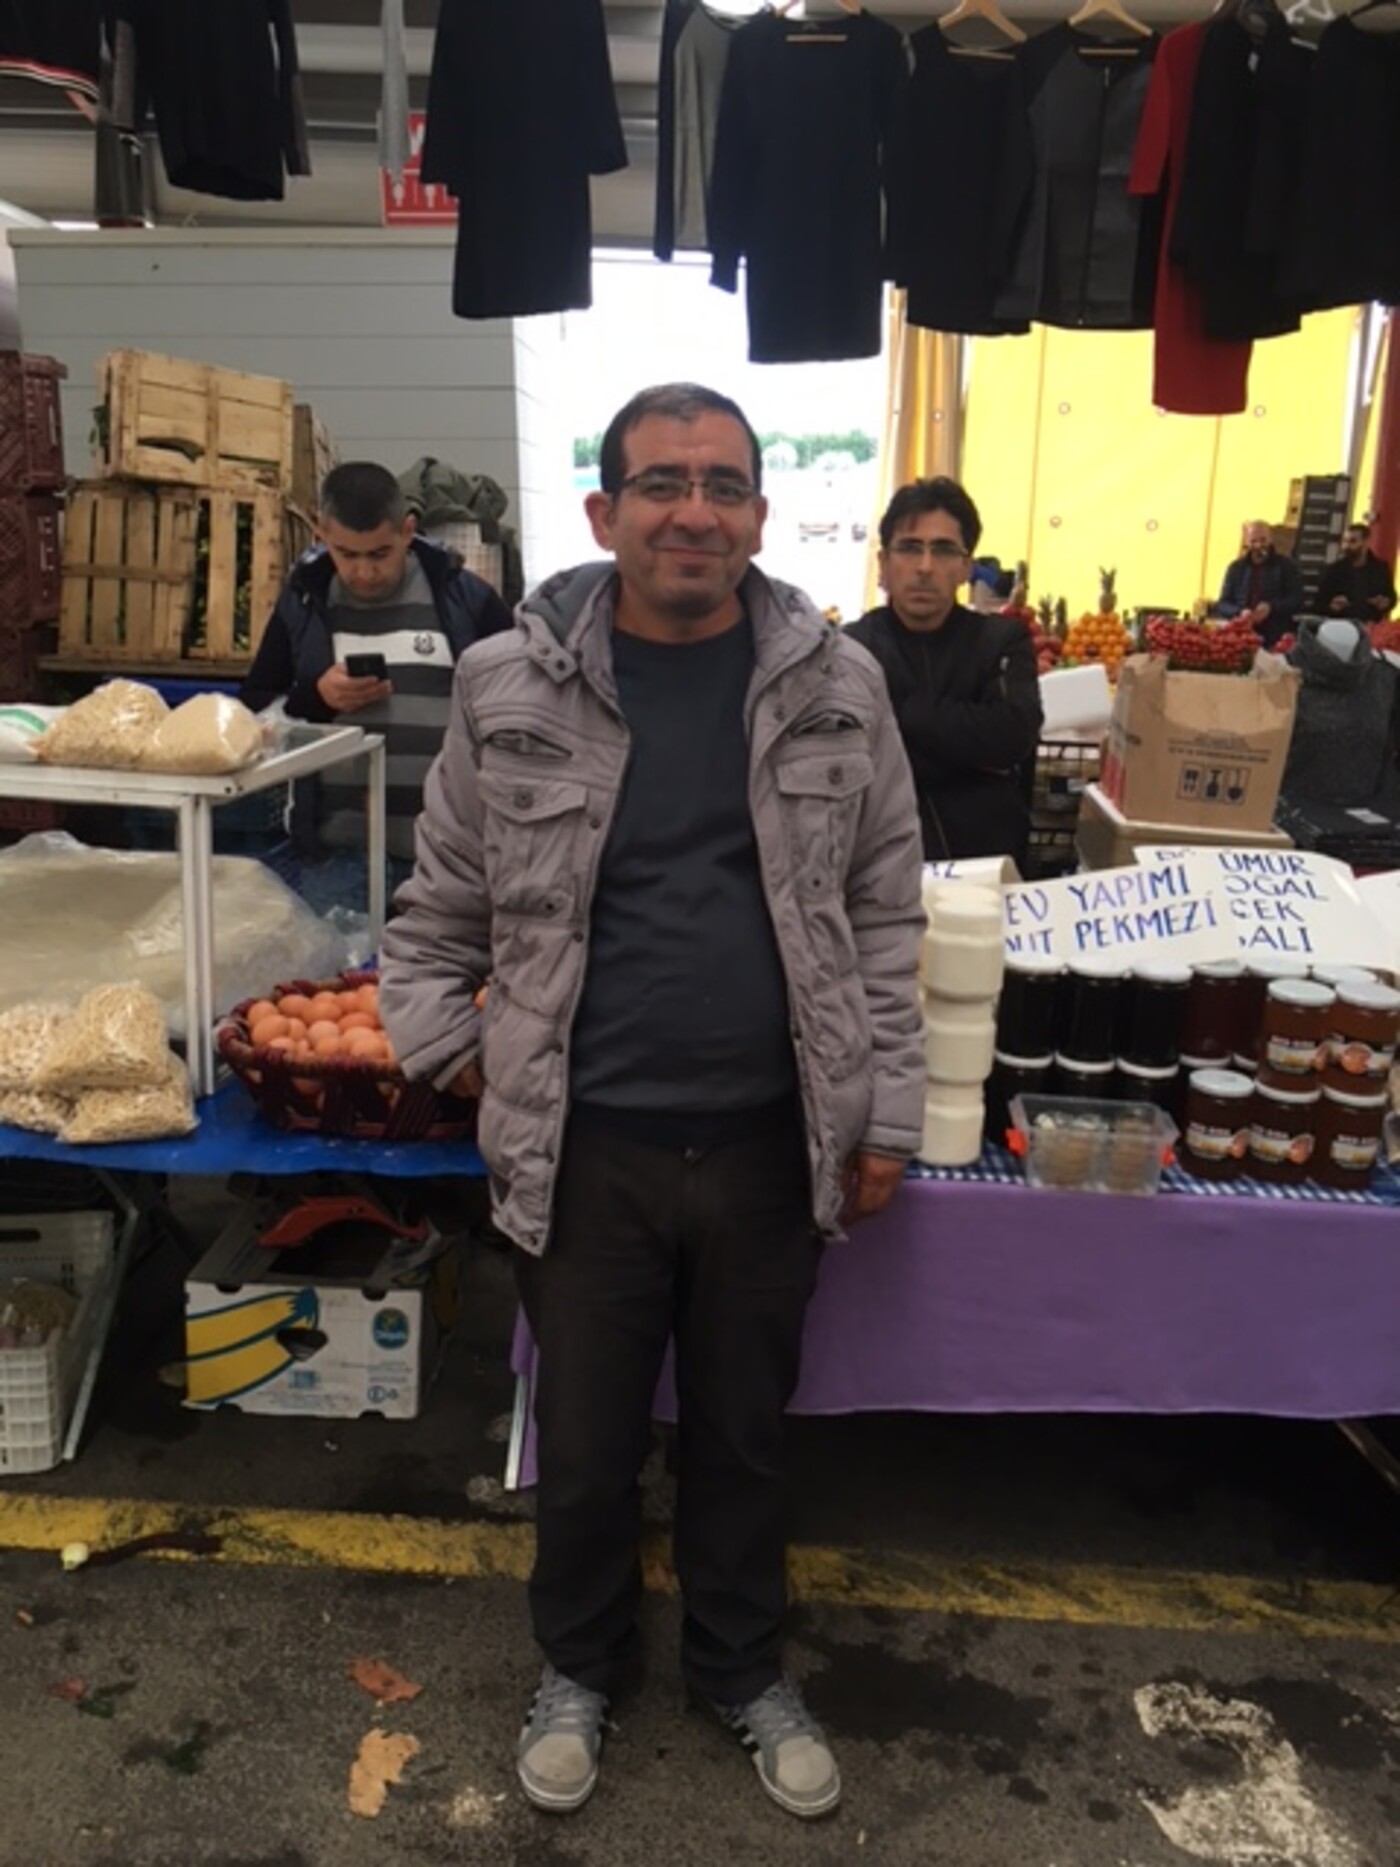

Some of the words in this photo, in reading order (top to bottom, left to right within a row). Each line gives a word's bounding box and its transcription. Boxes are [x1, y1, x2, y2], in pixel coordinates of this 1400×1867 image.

[1005, 888, 1048, 925] EV
[1067, 864, 1191, 912] YAPIMI
[1075, 890, 1217, 951] PEKMEZİ
[1239, 924, 1313, 953] ALI
